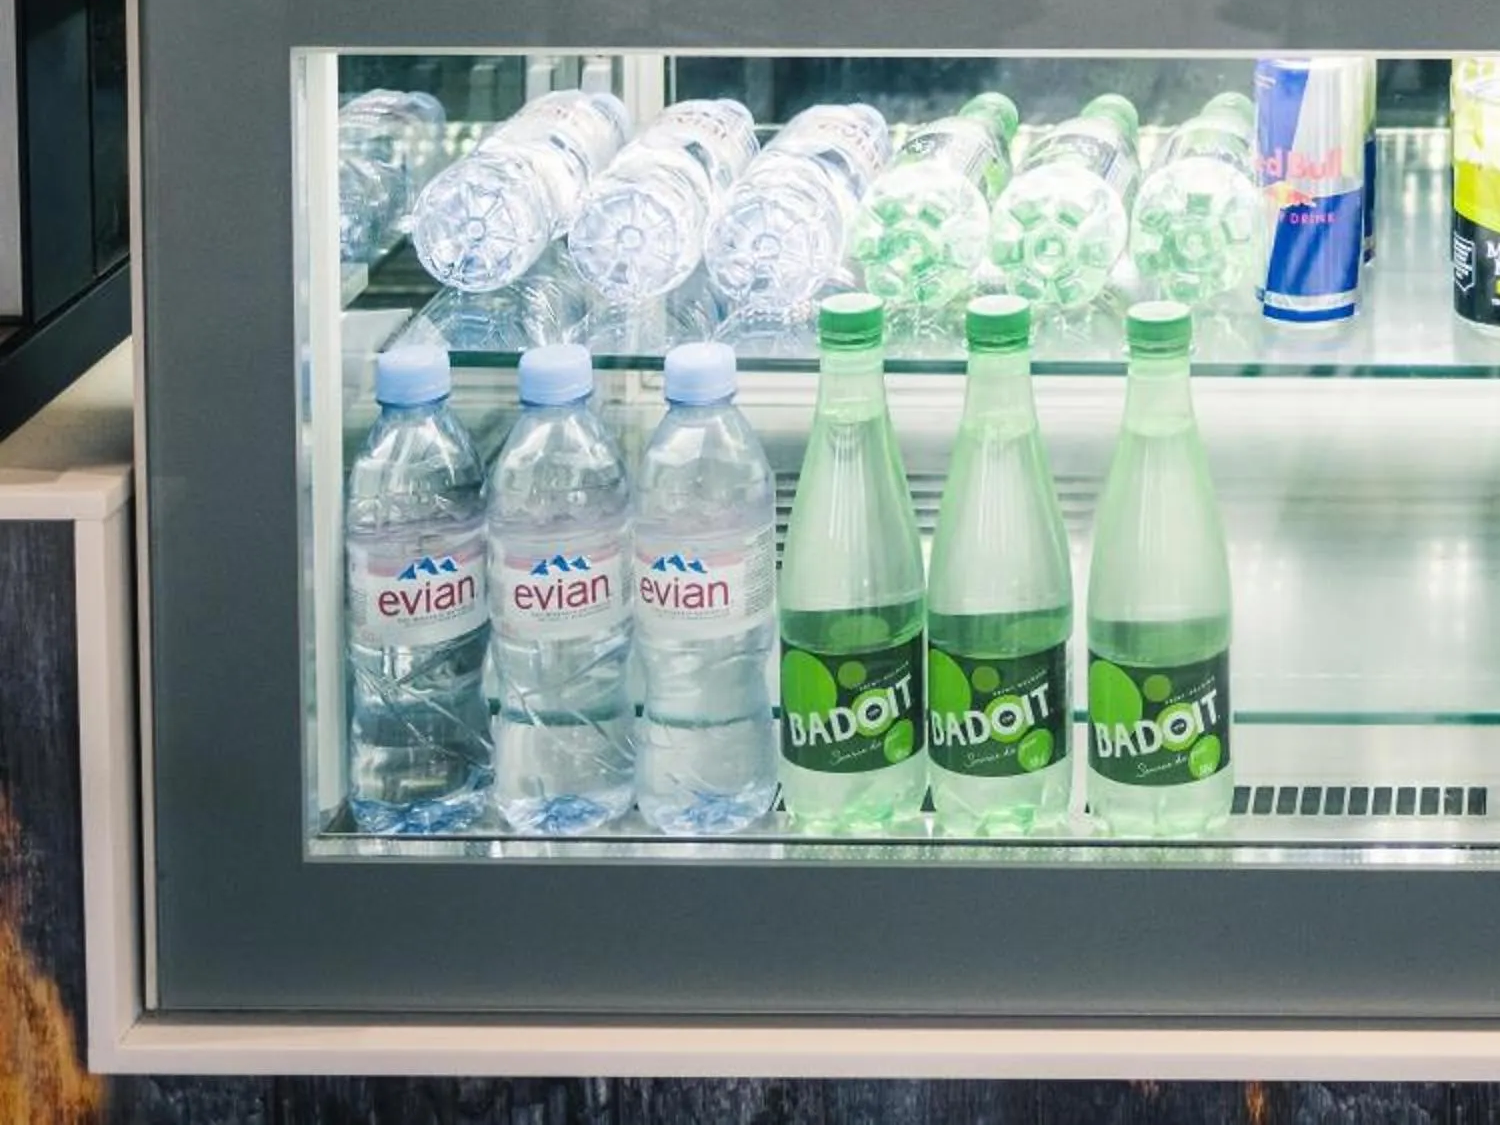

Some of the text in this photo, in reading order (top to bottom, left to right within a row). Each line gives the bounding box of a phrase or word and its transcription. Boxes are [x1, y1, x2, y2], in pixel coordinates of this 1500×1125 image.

[378, 575, 474, 616] evian
[514, 574, 609, 610] evian
[640, 576, 729, 608] evian
[788, 672, 912, 747] BADOIT
[930, 682, 1050, 747] BADOIT
[1094, 688, 1217, 758] BADOIT
